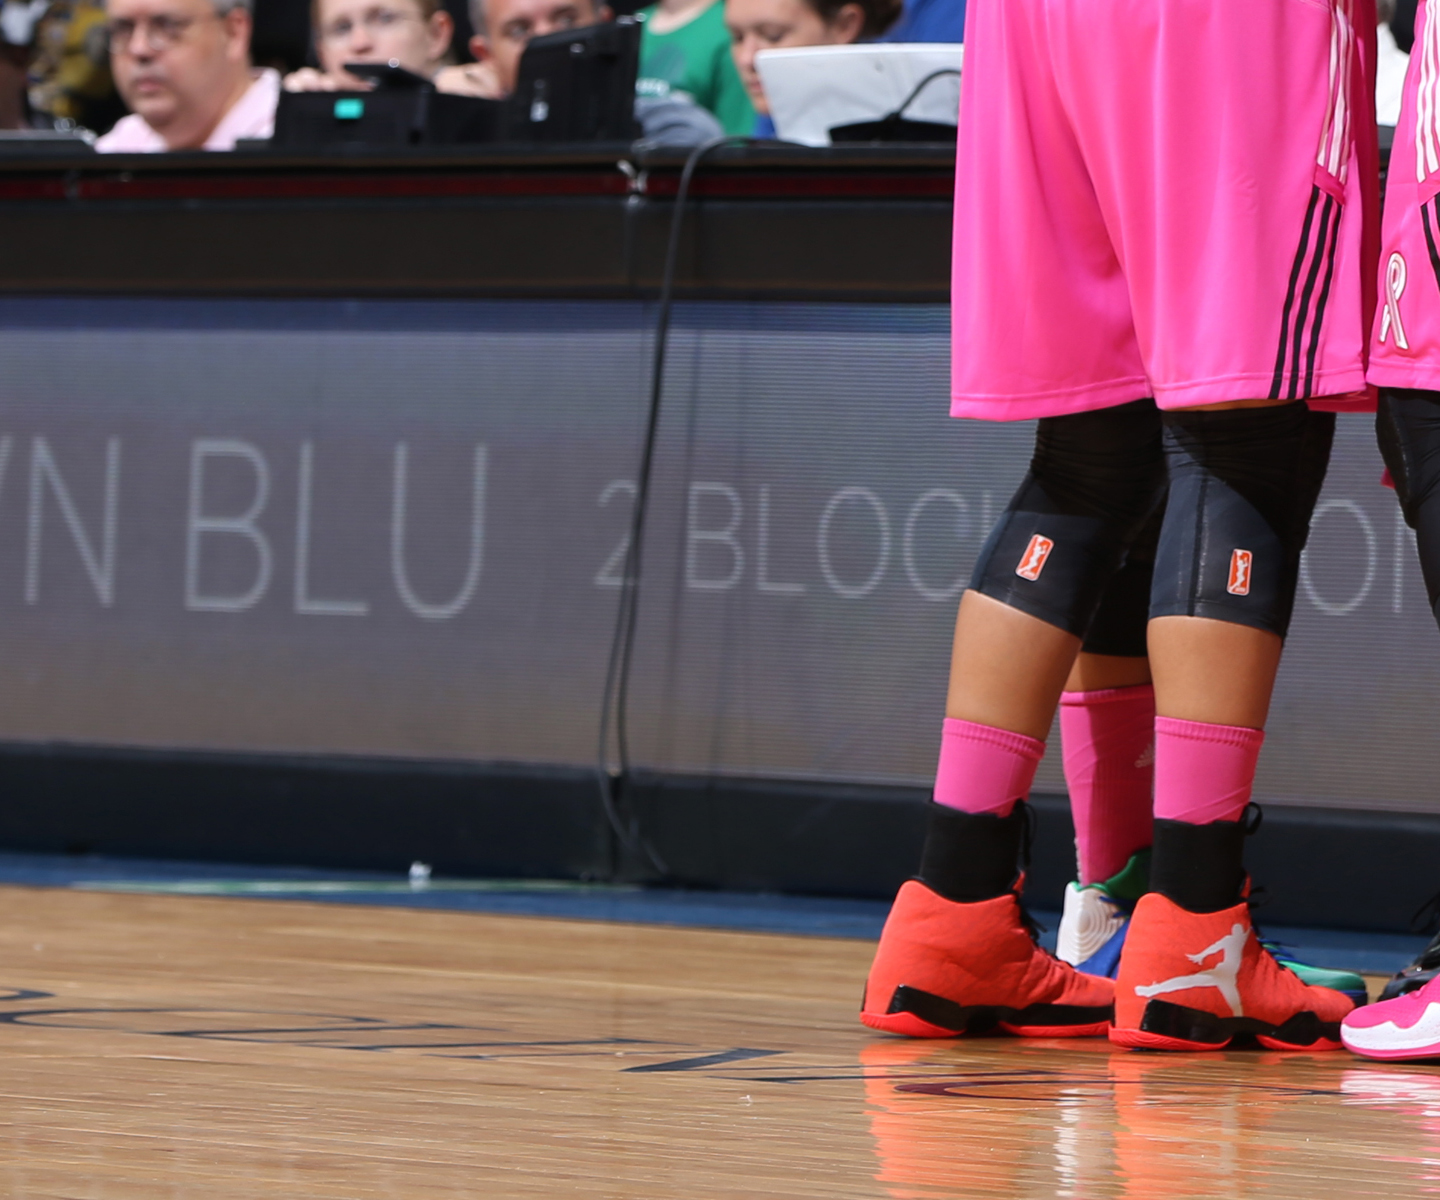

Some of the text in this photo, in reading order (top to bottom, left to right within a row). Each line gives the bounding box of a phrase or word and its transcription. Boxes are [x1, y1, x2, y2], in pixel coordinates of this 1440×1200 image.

[0, 436, 489, 619] N BLU
[594, 479, 641, 586] 2
